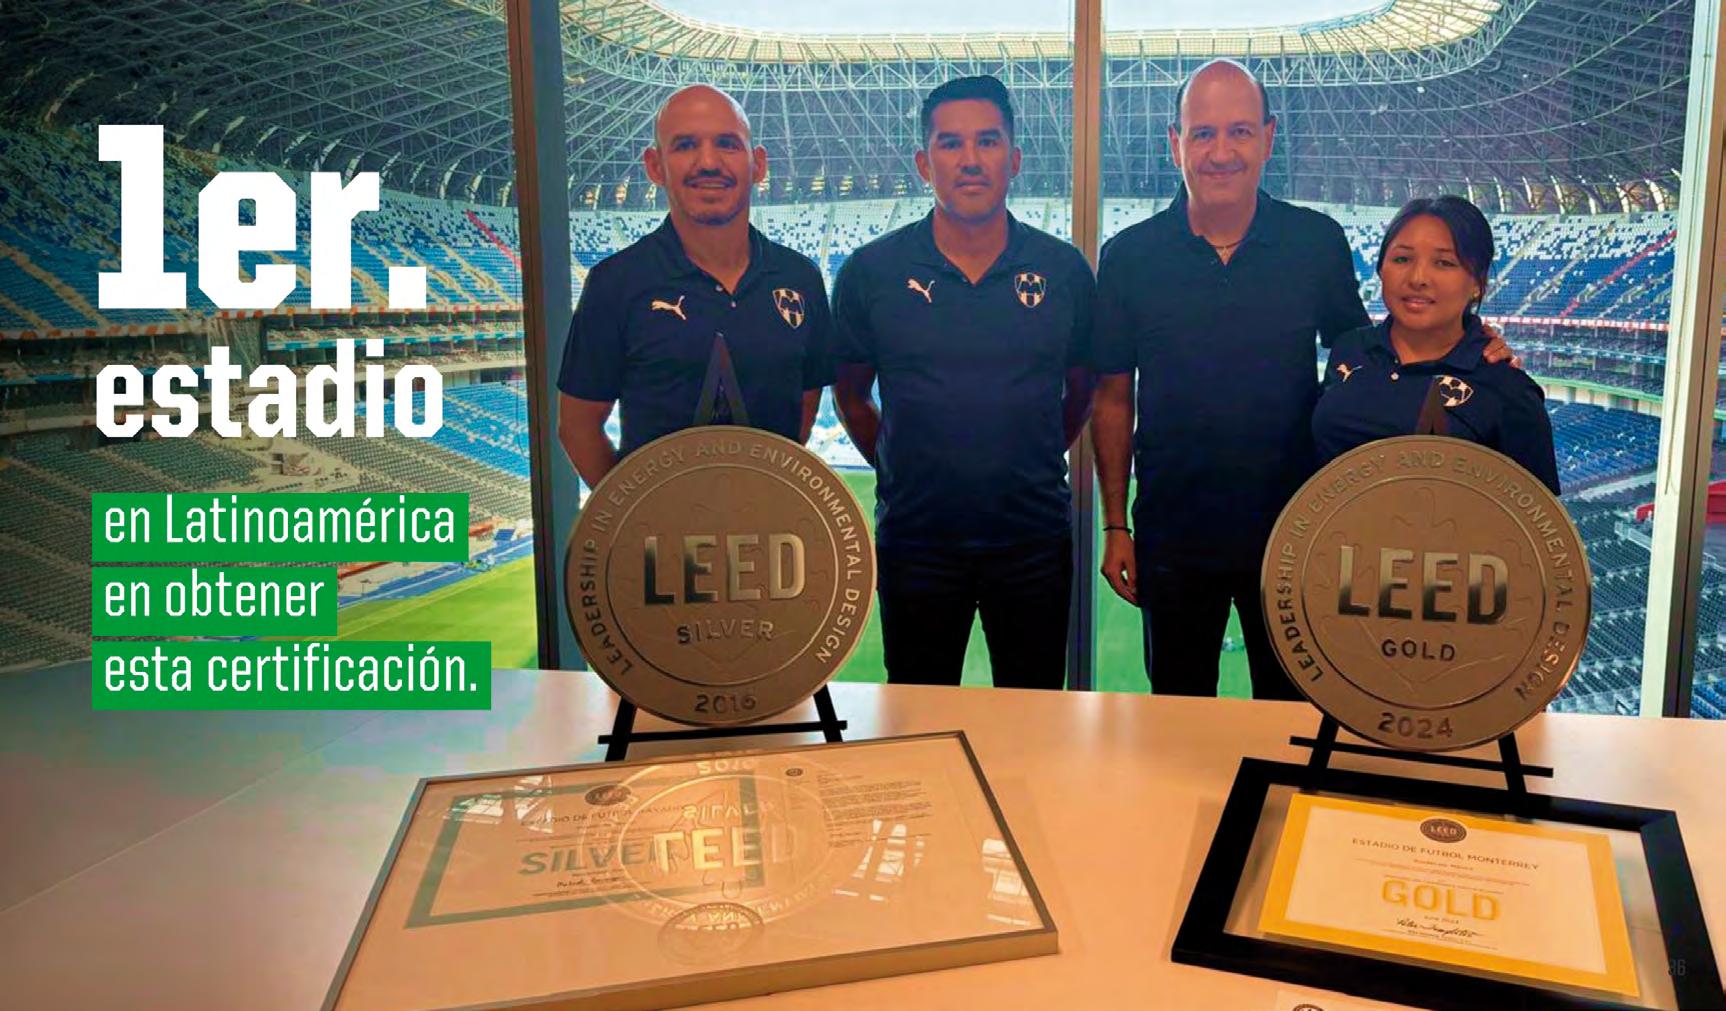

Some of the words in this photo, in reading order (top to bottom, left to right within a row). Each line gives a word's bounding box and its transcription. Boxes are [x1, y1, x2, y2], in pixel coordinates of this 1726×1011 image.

[696, 439, 741, 457] AND
[608, 446, 687, 506] ENERGY
[592, 511, 613, 532] IN
[749, 443, 862, 580] ENVIRONMENTAL
[1289, 516, 1311, 539] IN
[1453, 457, 1573, 611] ENVIRONMENTAL
[644, 533, 806, 606] LEED
[1338, 545, 1509, 625] LEED
[580, 540, 633, 676] LEADERSHIP
[676, 619, 775, 645] SILVER
[816, 589, 860, 663] DESIGN
[1278, 542, 1324, 682] LEADERSHIP
[1381, 638, 1456, 662] GOLD
[1377, 712, 1454, 739] 2024
[1352, 838, 1399, 852] ESTADIO
[1402, 844, 1417, 853] DE
[1420, 847, 1464, 860] FUTBOL
[1467, 854, 1540, 870] MONTERREY
[1381, 879, 1501, 921] GOLD
